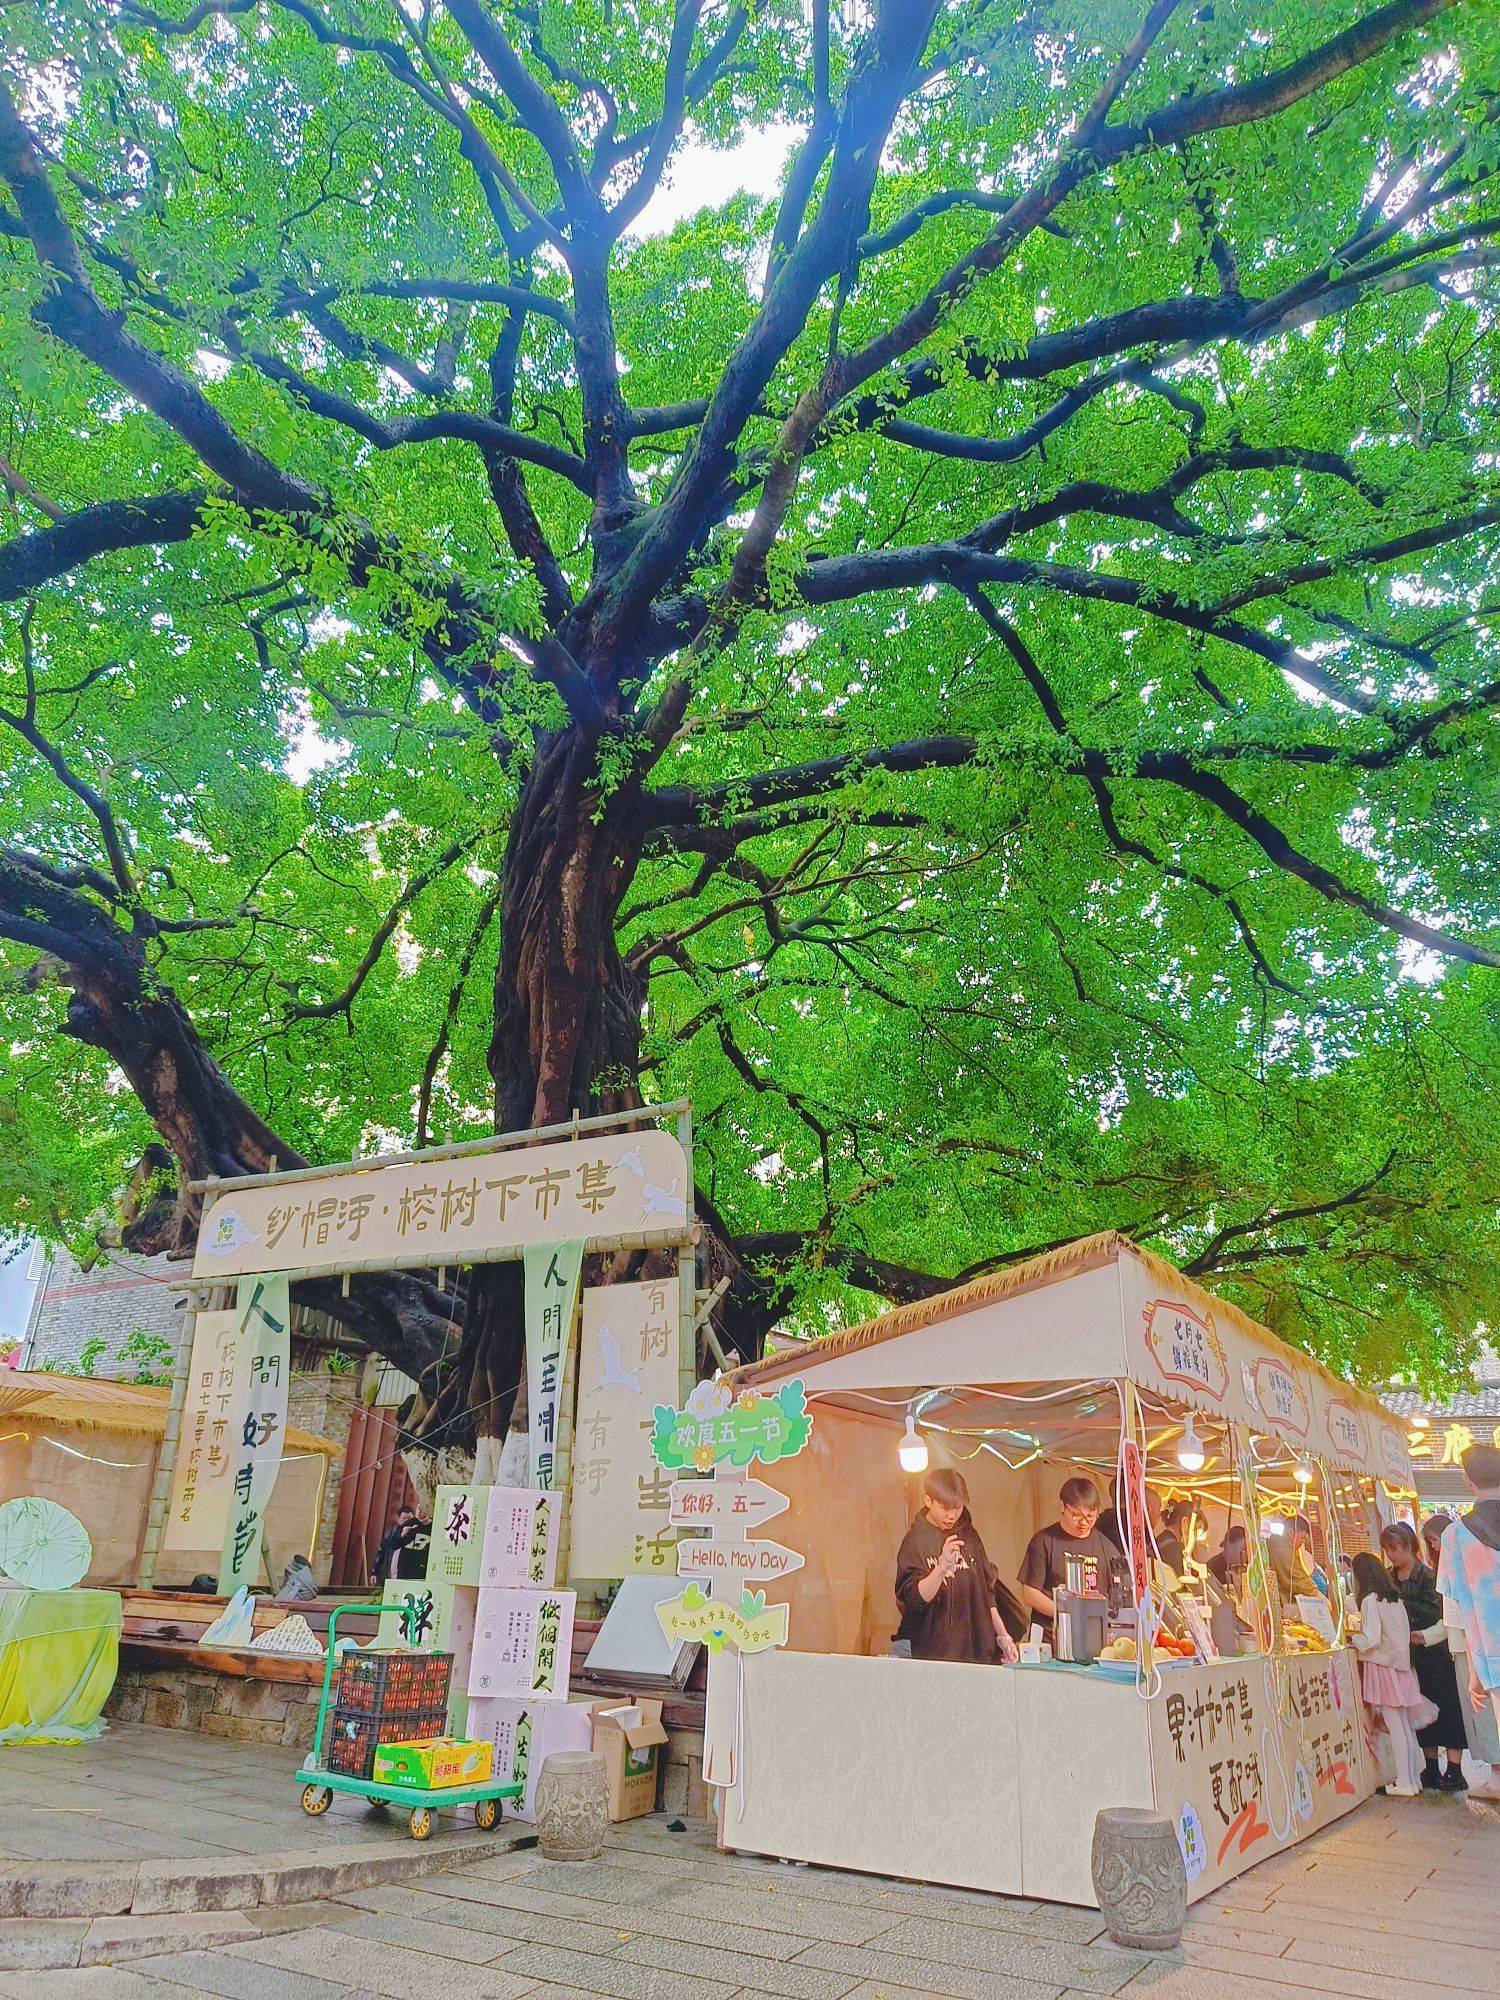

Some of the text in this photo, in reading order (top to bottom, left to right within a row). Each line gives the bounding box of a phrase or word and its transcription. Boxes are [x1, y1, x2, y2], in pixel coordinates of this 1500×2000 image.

[677, 1416, 781, 1447] 欢度五一节
[444, 1494, 470, 1546] 茶
[530, 1497, 550, 1582] 人生如茶
[691, 1549, 788, 1571] Hello, May Day
[1166, 1677, 1253, 1763] 果汁和市集
